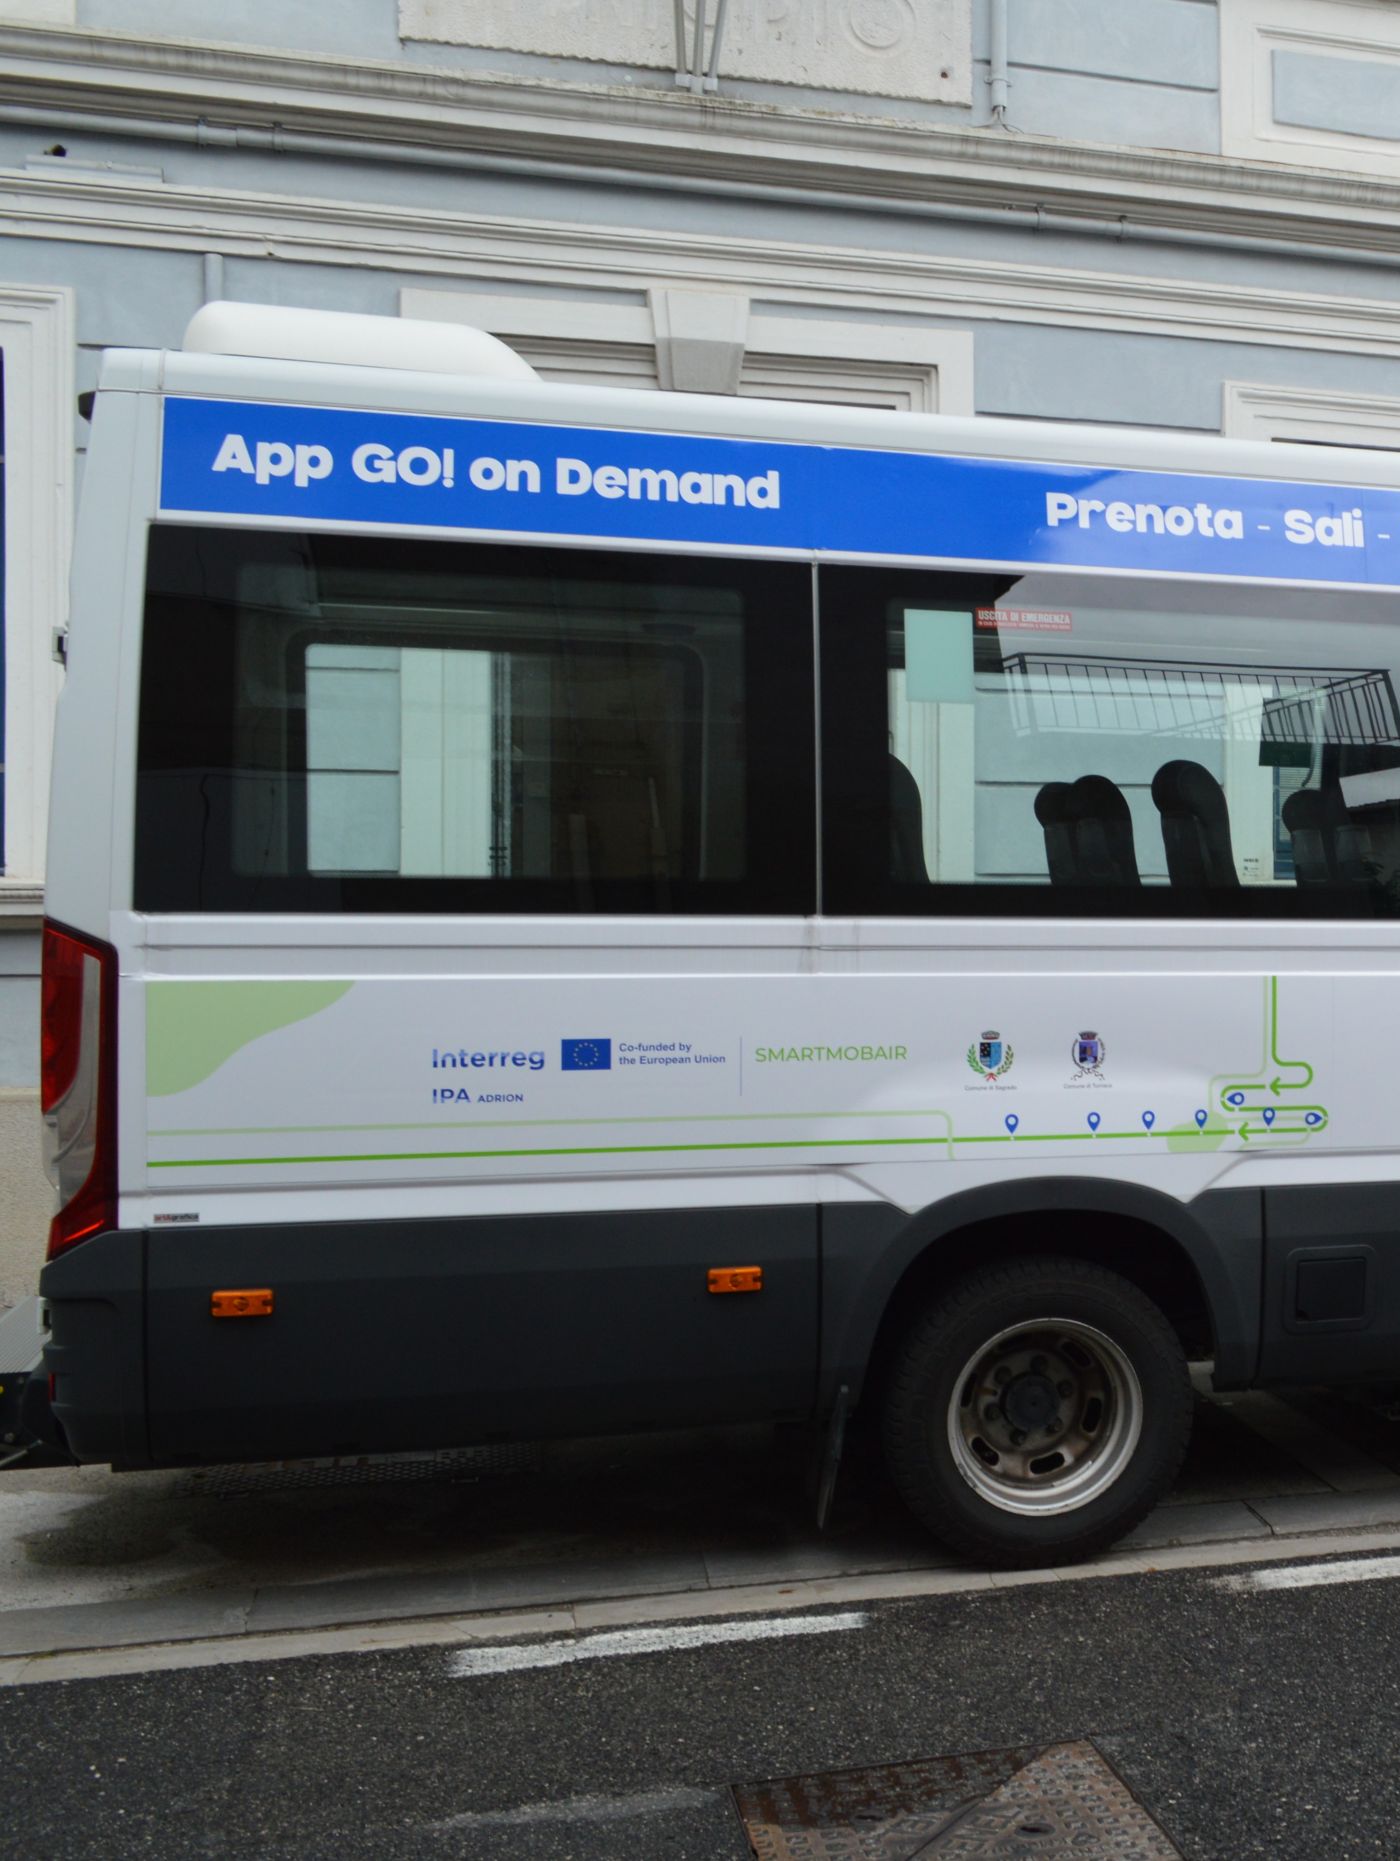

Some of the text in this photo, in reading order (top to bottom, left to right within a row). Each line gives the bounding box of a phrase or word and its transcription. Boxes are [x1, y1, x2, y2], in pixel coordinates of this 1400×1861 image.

[211, 433, 780, 510] App GO! on Demand
[1045, 491, 1244, 540] Prenota
[1283, 508, 1365, 549] Sali
[618, 1041, 692, 1056] Co-funded by
[754, 1045, 908, 1063] SMARTMOBAIR
[432, 1048, 546, 1070] Interreg
[619, 1053, 727, 1067] the European Union
[432, 1088, 524, 1104] IPA ADRION
